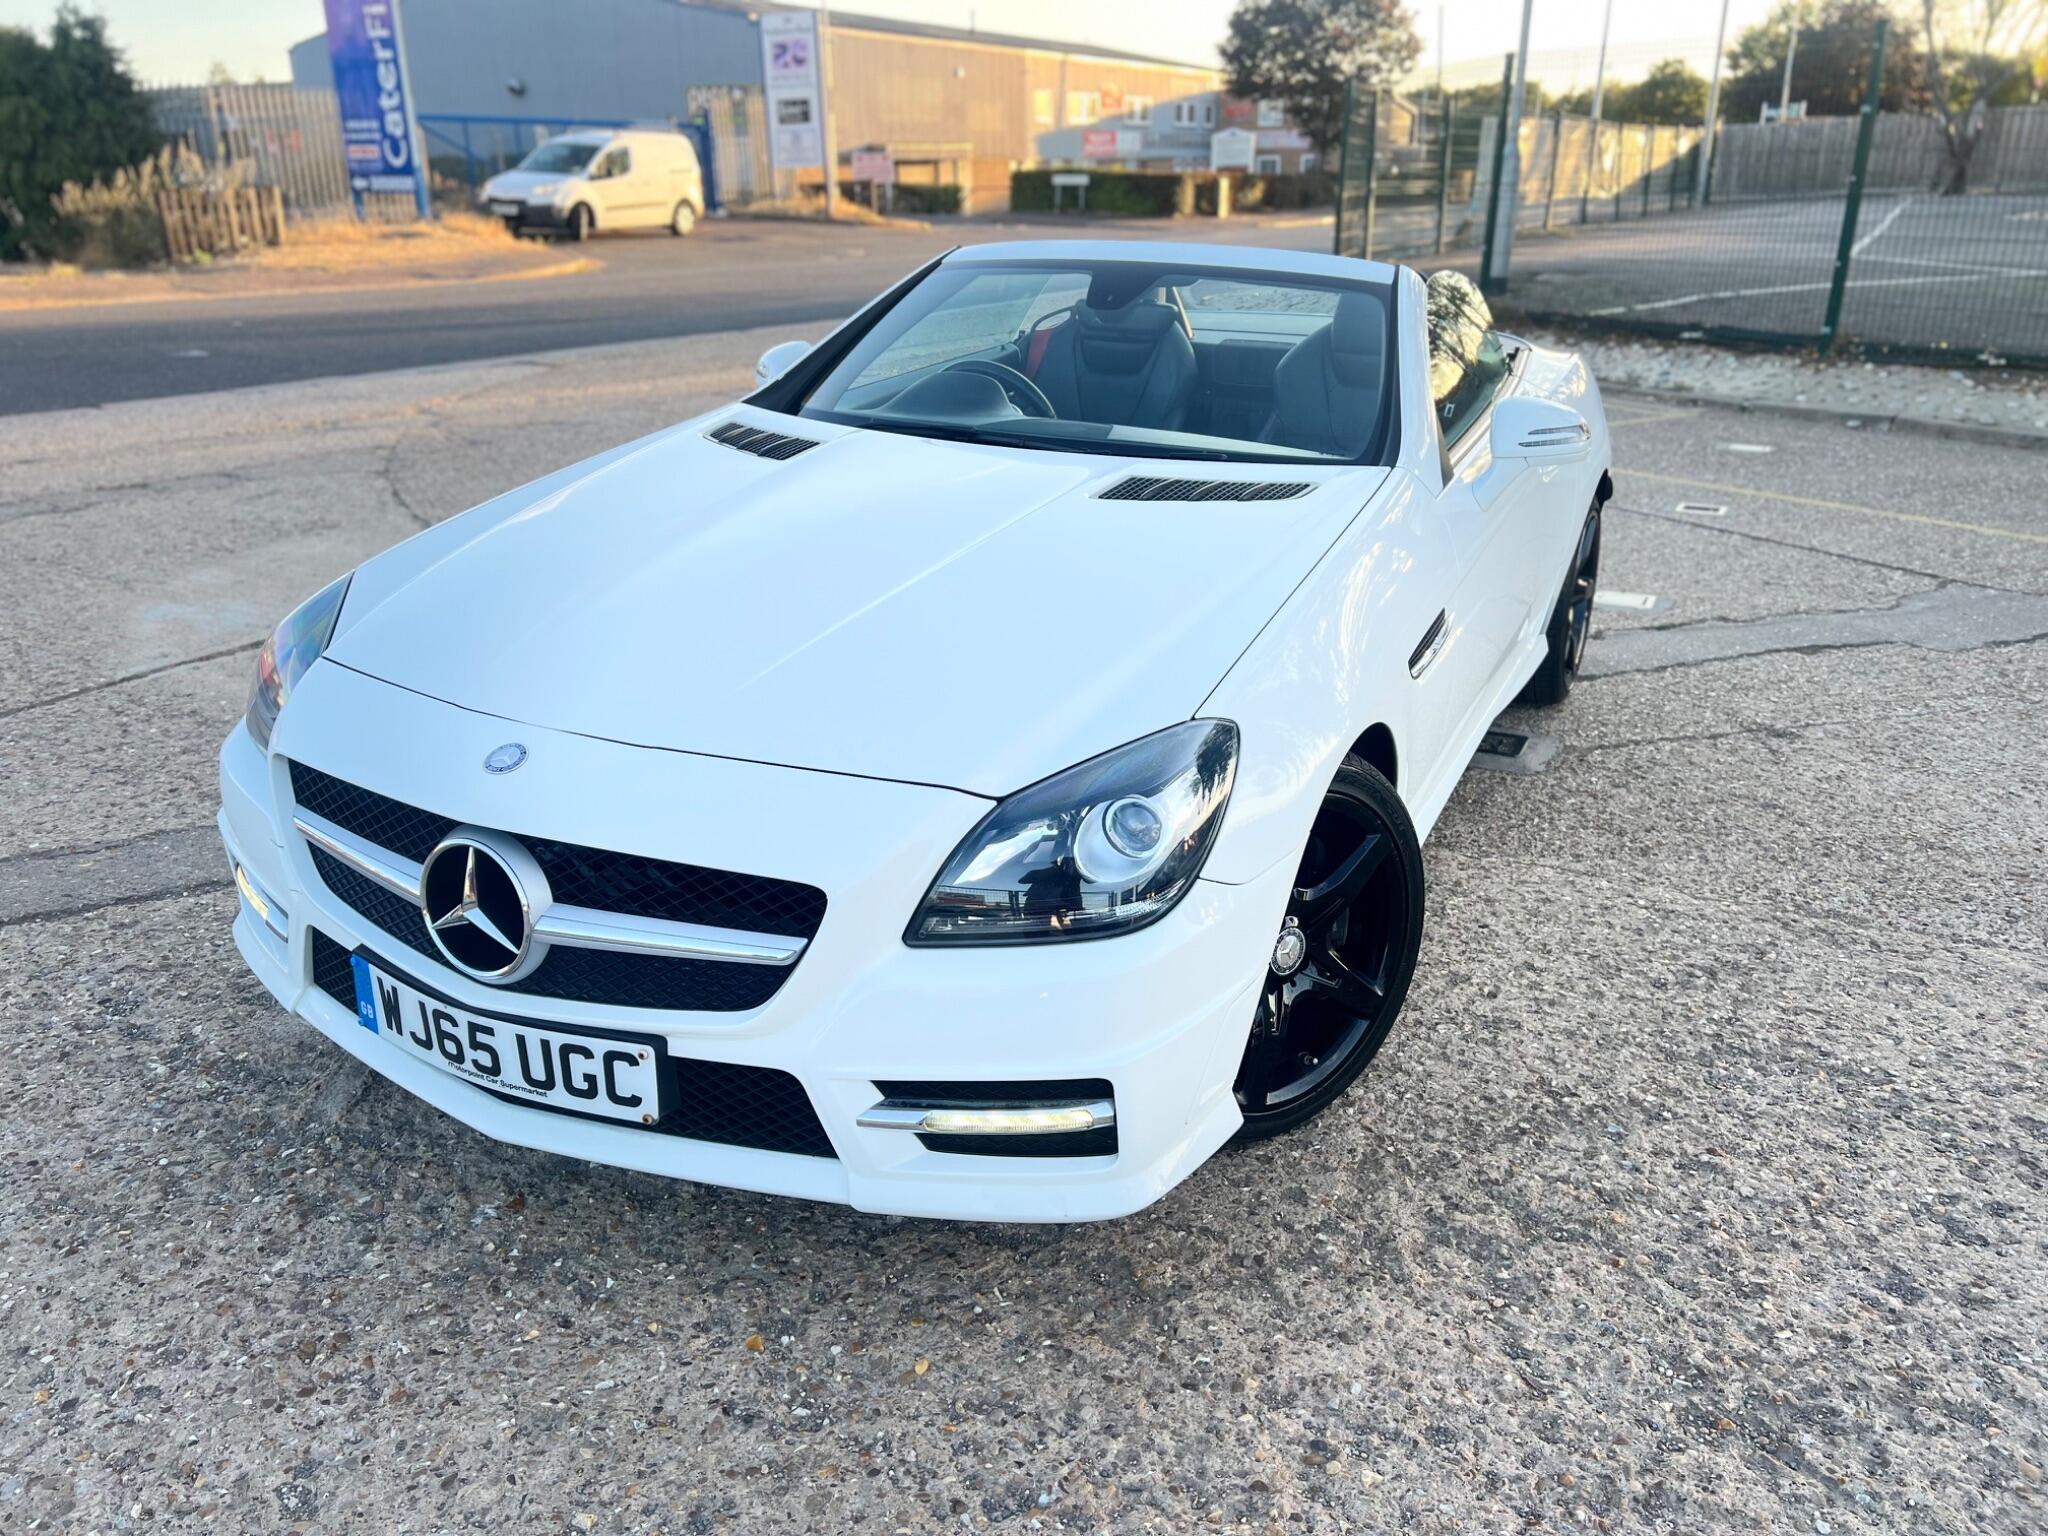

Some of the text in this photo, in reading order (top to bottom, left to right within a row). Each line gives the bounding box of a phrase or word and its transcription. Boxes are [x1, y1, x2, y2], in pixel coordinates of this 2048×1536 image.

[360, 1000, 374, 1019] GB
[377, 975, 644, 1109] WJ65 UGC
[486, 1075, 499, 1085] Car
[499, 1079, 549, 1098] Supermarket
